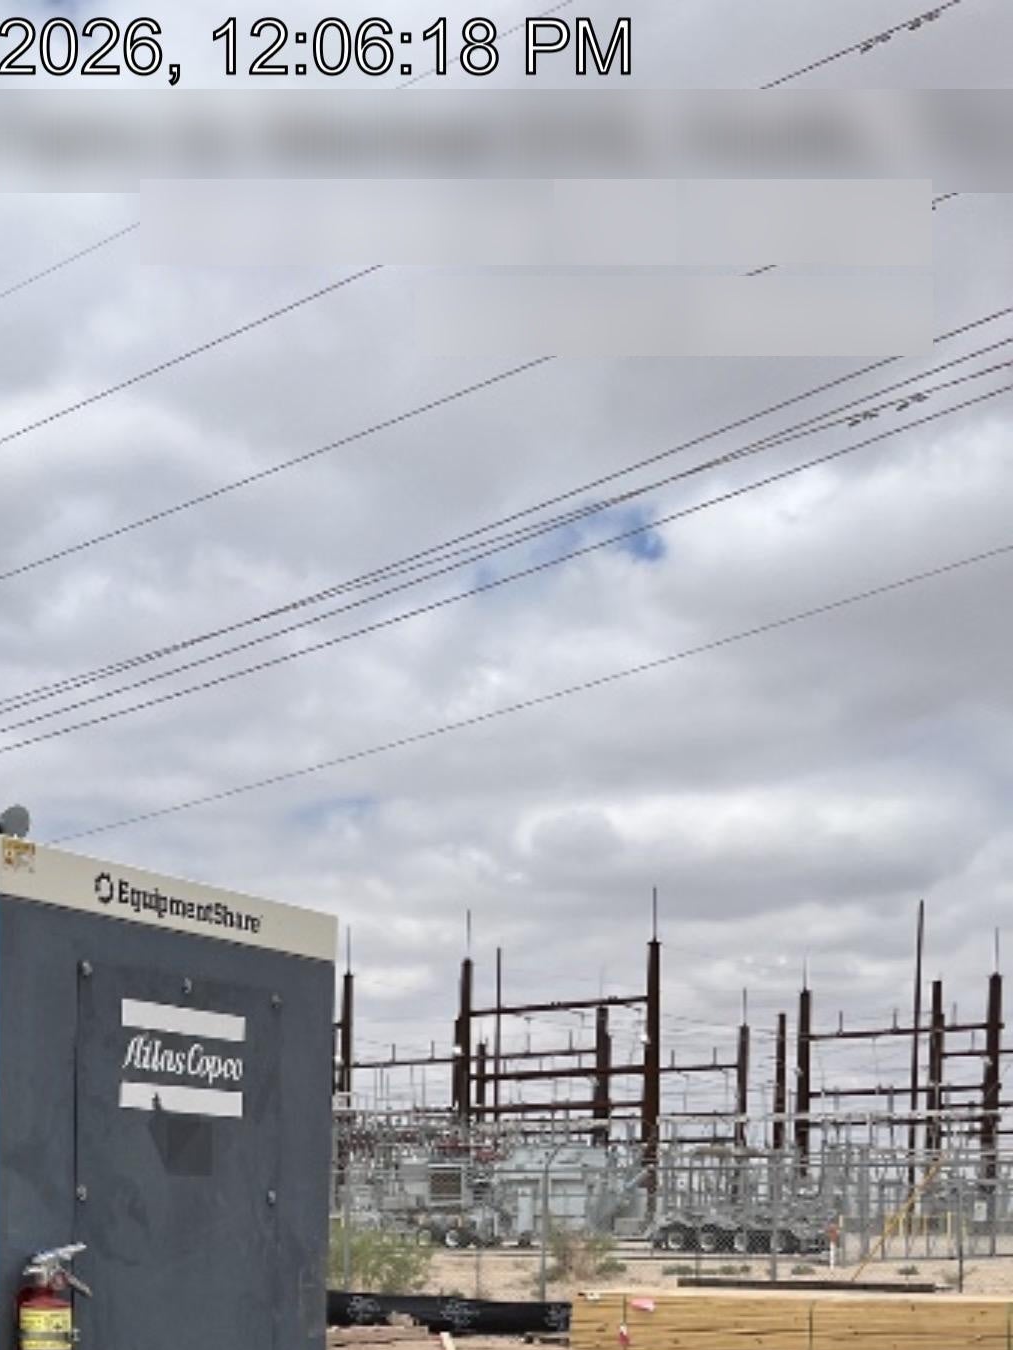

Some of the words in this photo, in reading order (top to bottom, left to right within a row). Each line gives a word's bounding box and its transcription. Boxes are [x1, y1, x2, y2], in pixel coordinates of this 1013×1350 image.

[118, 877, 261, 934] EquipmentShare
[121, 1036, 186, 1075] Atlas
[188, 1043, 243, 1086] Copco
